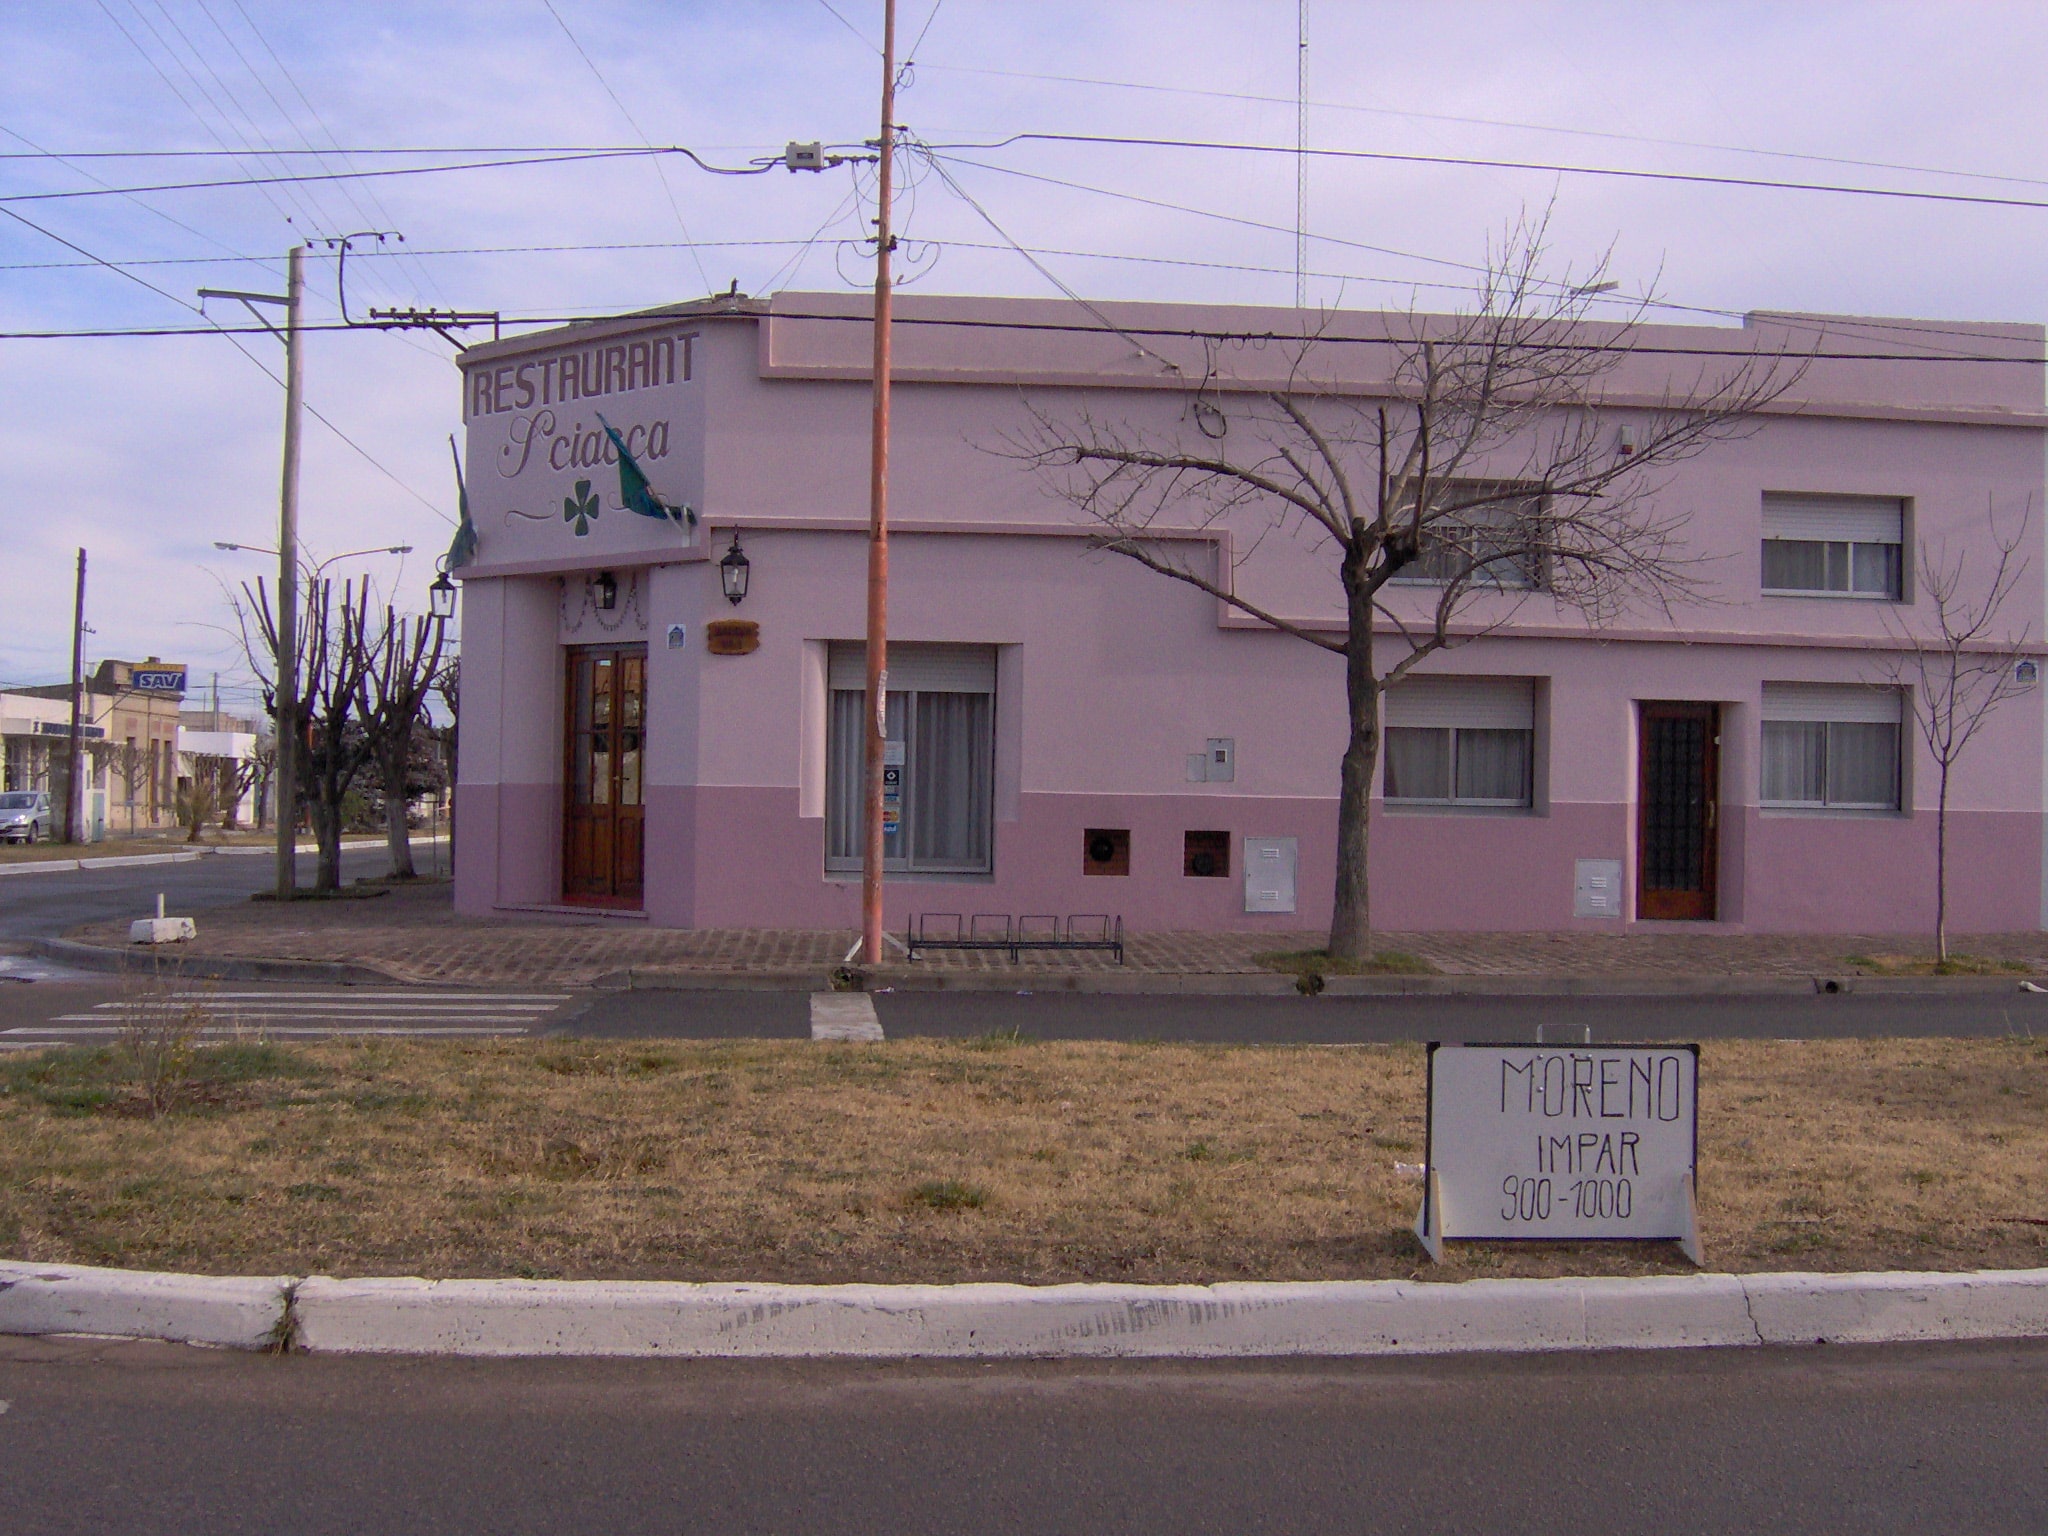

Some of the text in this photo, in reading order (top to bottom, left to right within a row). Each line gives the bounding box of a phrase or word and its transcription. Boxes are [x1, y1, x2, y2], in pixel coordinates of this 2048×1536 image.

[473, 333, 700, 416] RESTAURANT
[139, 673, 183, 689] SAV
[1502, 1056, 1680, 1121] MORENO
[1538, 1131, 1640, 1176] IMPAR
